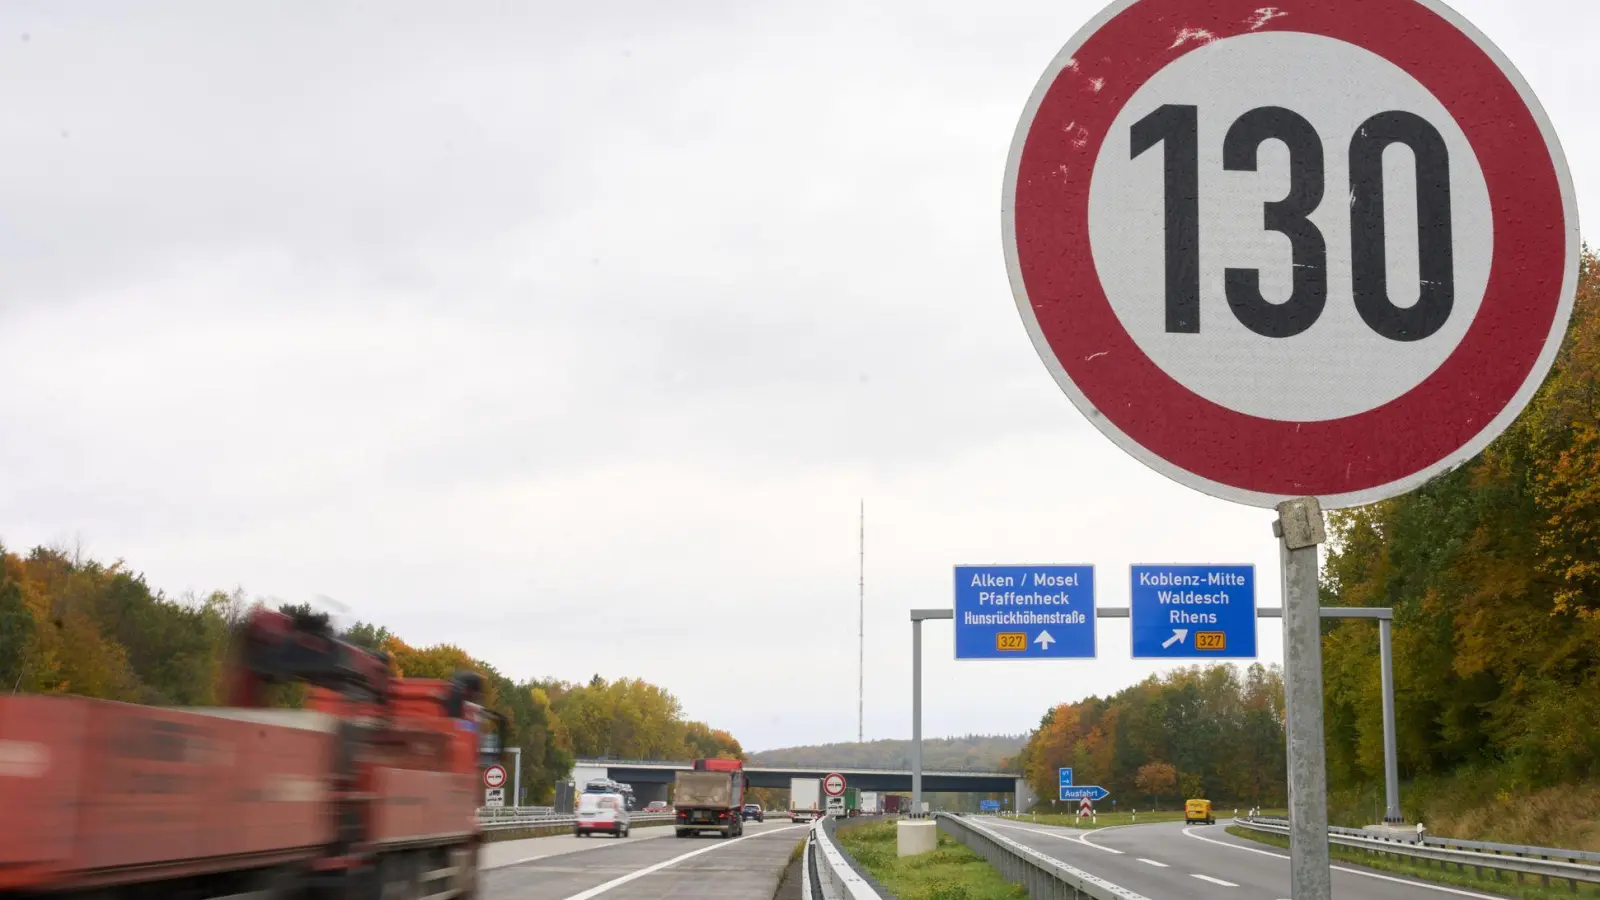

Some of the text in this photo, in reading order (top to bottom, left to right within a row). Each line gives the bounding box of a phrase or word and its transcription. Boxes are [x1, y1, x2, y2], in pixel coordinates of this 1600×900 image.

[1129, 104, 1454, 342] 130
[971, 573, 1079, 587] Alken / Mosel
[1140, 572, 1246, 586] Koblenz-Mitte
[979, 592, 1070, 606] Pfaffenheck
[1157, 591, 1230, 605] Waldesch
[964, 611, 1086, 625] Hunsrückhöhenstraße
[1169, 610, 1218, 624] Rhens
[1000, 636, 1023, 648] 327
[1199, 635, 1222, 647] 327
[1065, 789, 1098, 797] Ausfahrt
